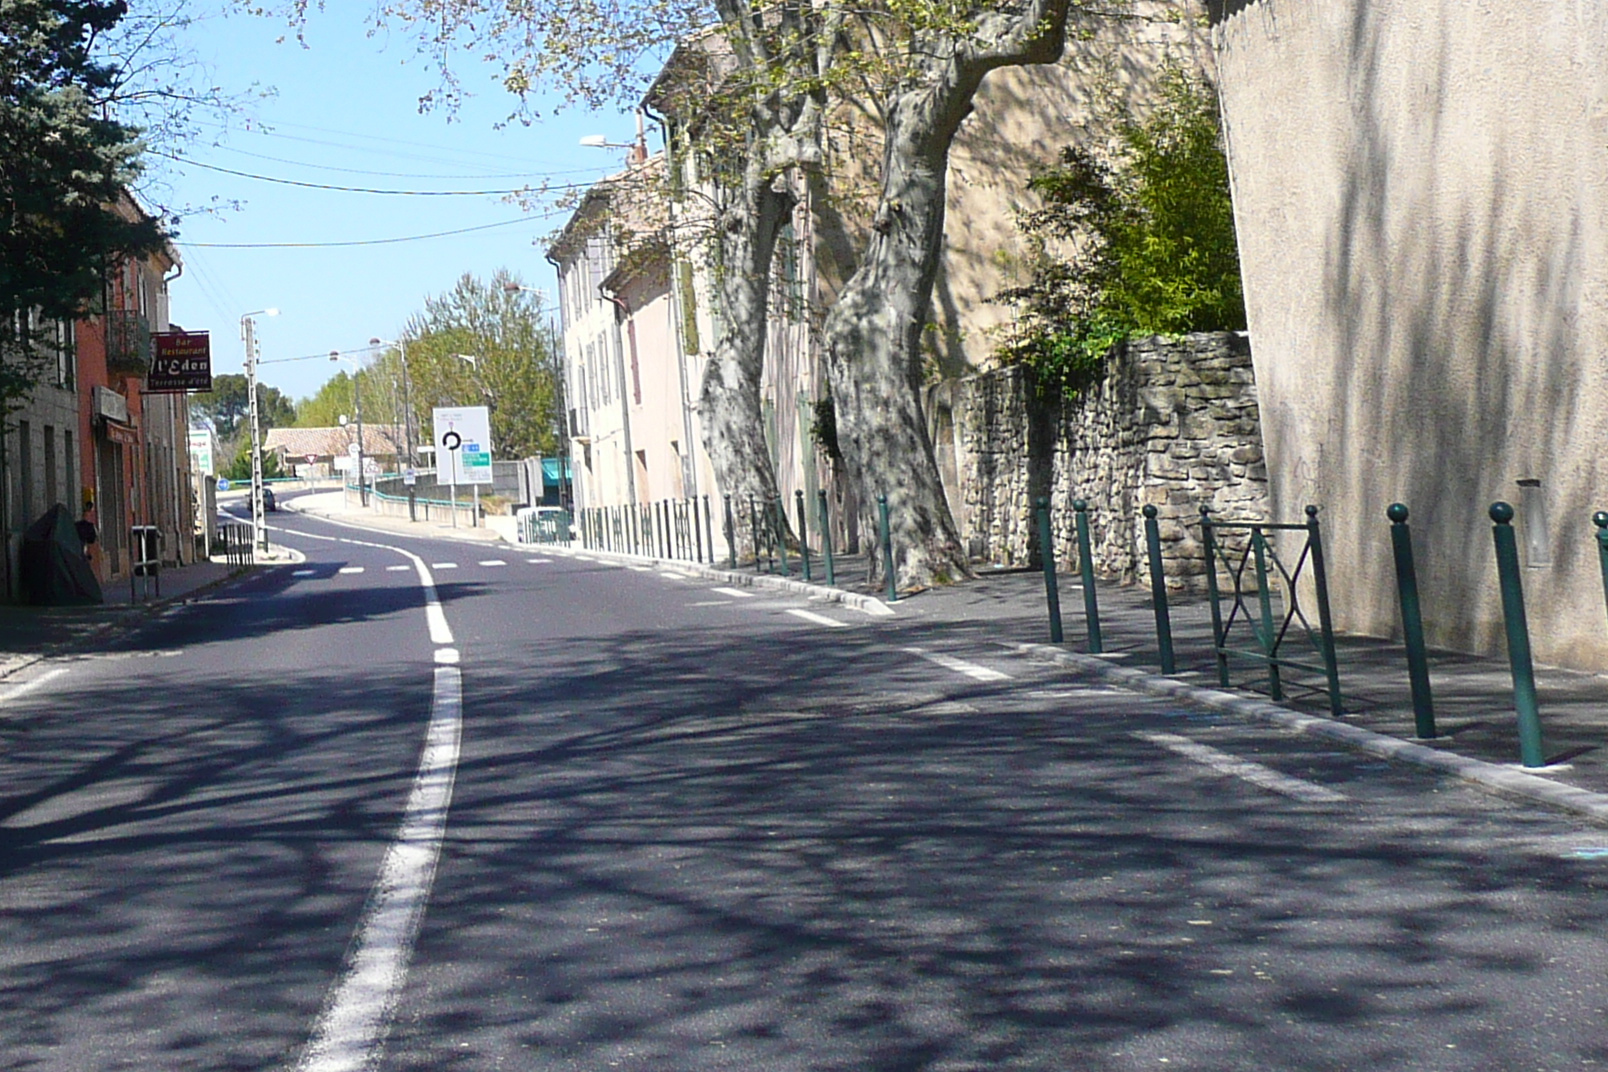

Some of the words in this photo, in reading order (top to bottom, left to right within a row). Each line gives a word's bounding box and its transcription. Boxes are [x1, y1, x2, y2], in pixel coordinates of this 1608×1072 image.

[175, 338, 192, 346] Bar
[161, 348, 206, 356] Restaurant
[158, 359, 208, 375] l'Eden
[150, 378, 186, 387] Terrasse
